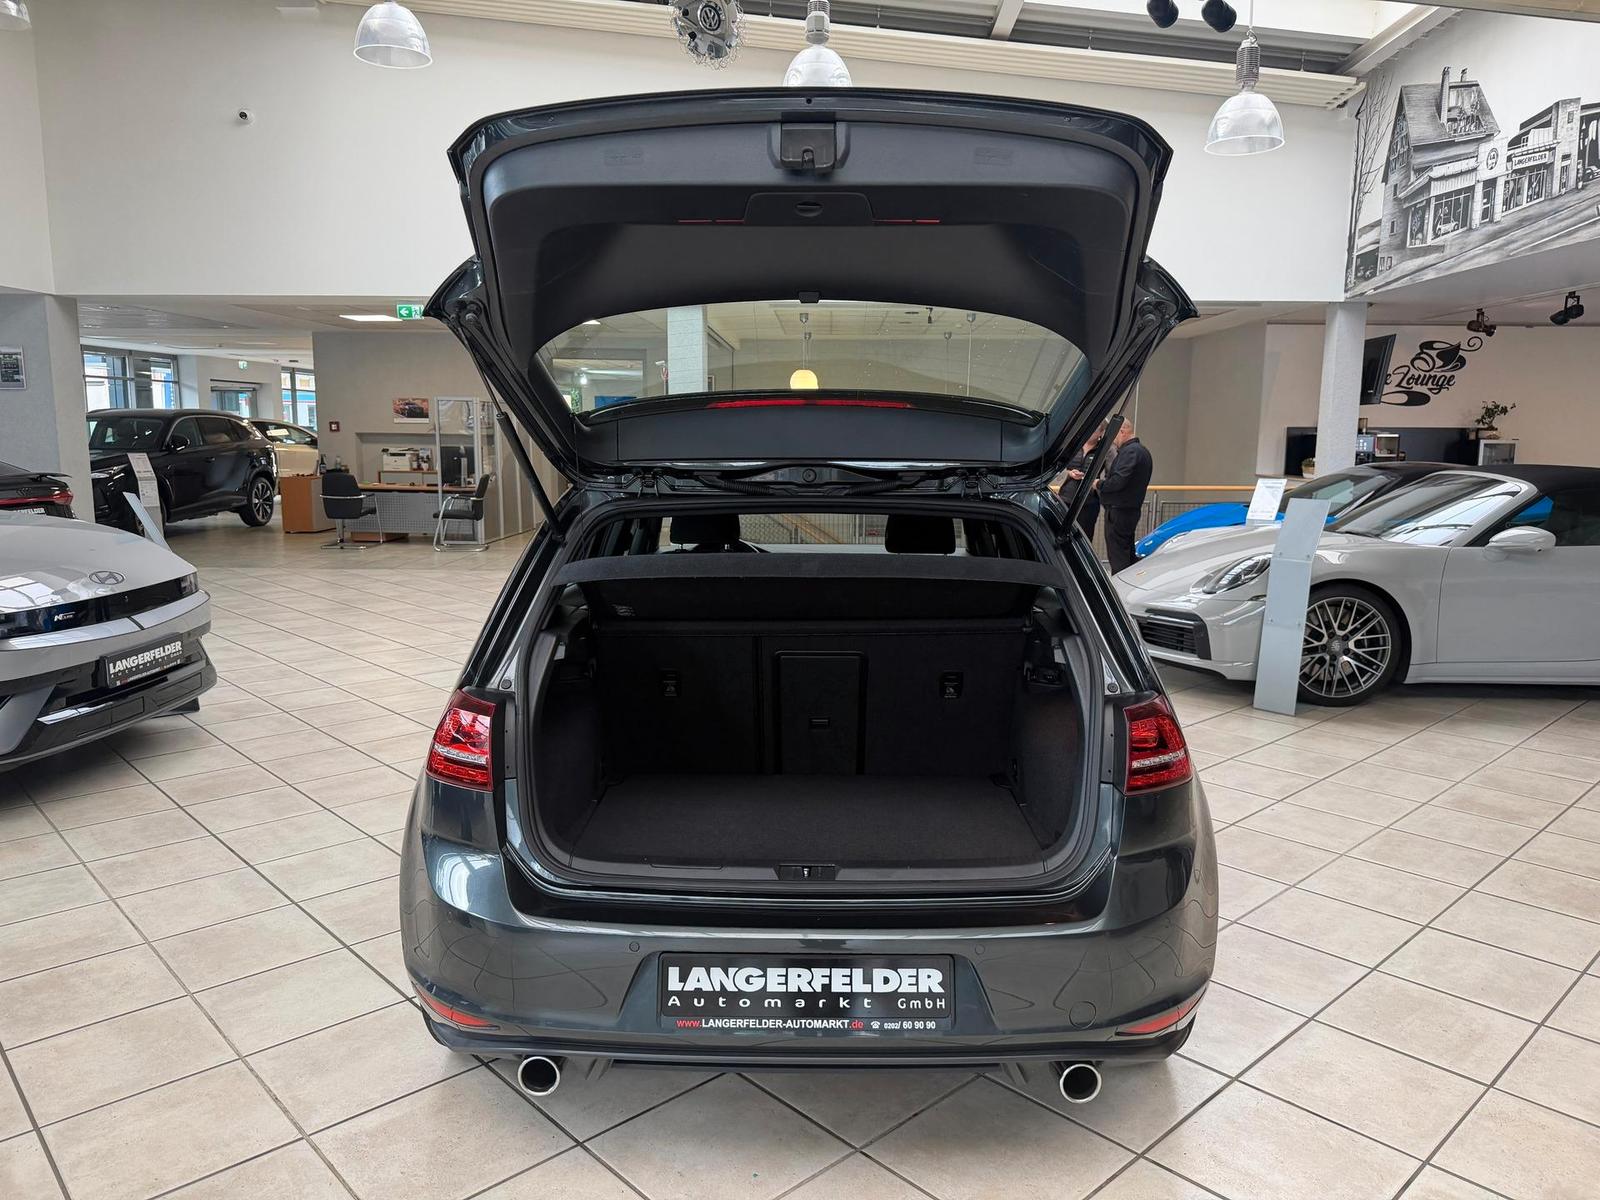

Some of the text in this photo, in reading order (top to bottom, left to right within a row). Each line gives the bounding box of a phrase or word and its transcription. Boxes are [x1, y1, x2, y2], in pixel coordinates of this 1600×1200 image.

[1514, 153, 1547, 166] LANGERFELDER
[1392, 365, 1456, 395] Lounge
[109, 640, 183, 674] LANGERFELDER
[668, 966, 945, 993] LANGERFELDER
[668, 996, 946, 1009] Automarkt GmbH
[676, 1018, 865, 1029] www.LANGERFELDER-AUTOMARKT.de
[902, 1020, 912, 1029] 60
[914, 1020, 924, 1029] 90
[925, 1020, 936, 1029] 90
